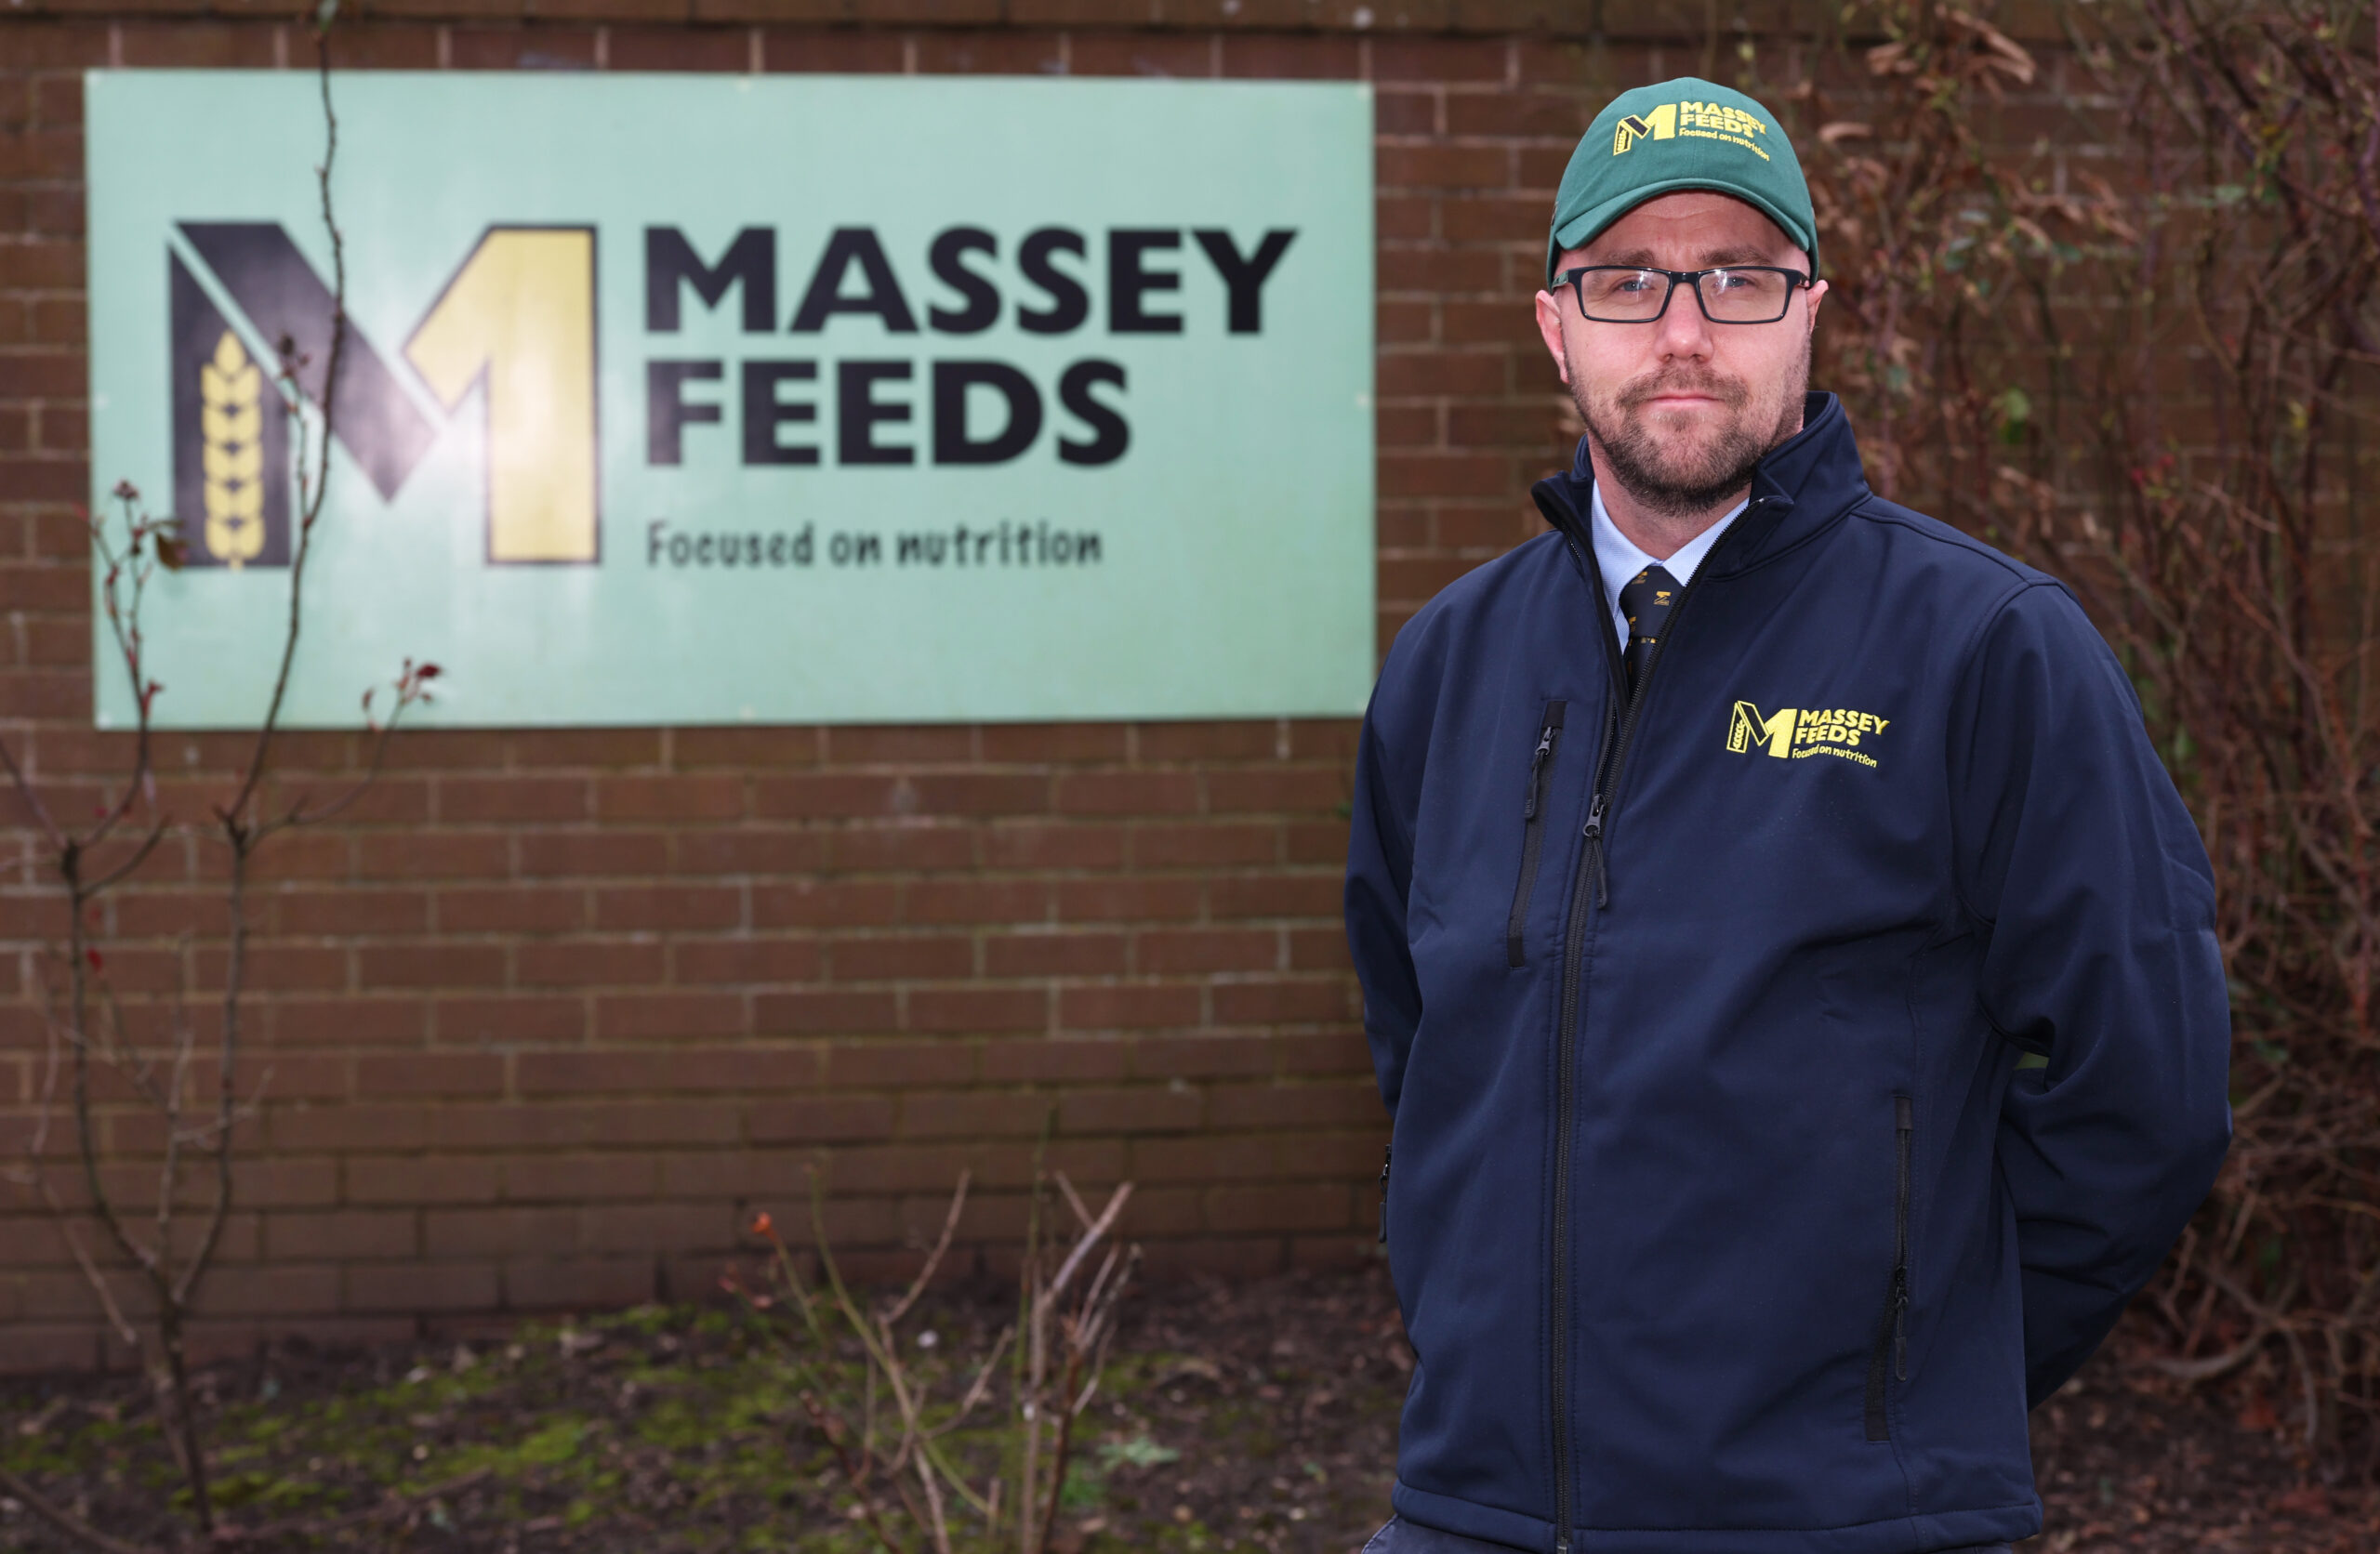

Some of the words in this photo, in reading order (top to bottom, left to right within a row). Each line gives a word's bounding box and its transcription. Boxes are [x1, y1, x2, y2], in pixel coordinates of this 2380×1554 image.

[1680, 100, 1766, 134] MASSEY
[1680, 113, 1755, 138] FEEDS
[1679, 127, 1718, 138] Focused
[1719, 133, 1732, 142] on
[1733, 136, 1770, 161] nutrition
[645, 225, 1300, 335] MASSEY
[645, 358, 1132, 468] FEEDS
[649, 520, 814, 568] Focused
[829, 533, 881, 567] on
[895, 520, 1103, 568] nutrition
[1794, 724, 1861, 746] FEEDS
[1798, 709, 1890, 735] MASSEY
[1792, 744, 1820, 759] Focused
[1818, 744, 1832, 756] on
[1832, 746, 1878, 769] nutrition
